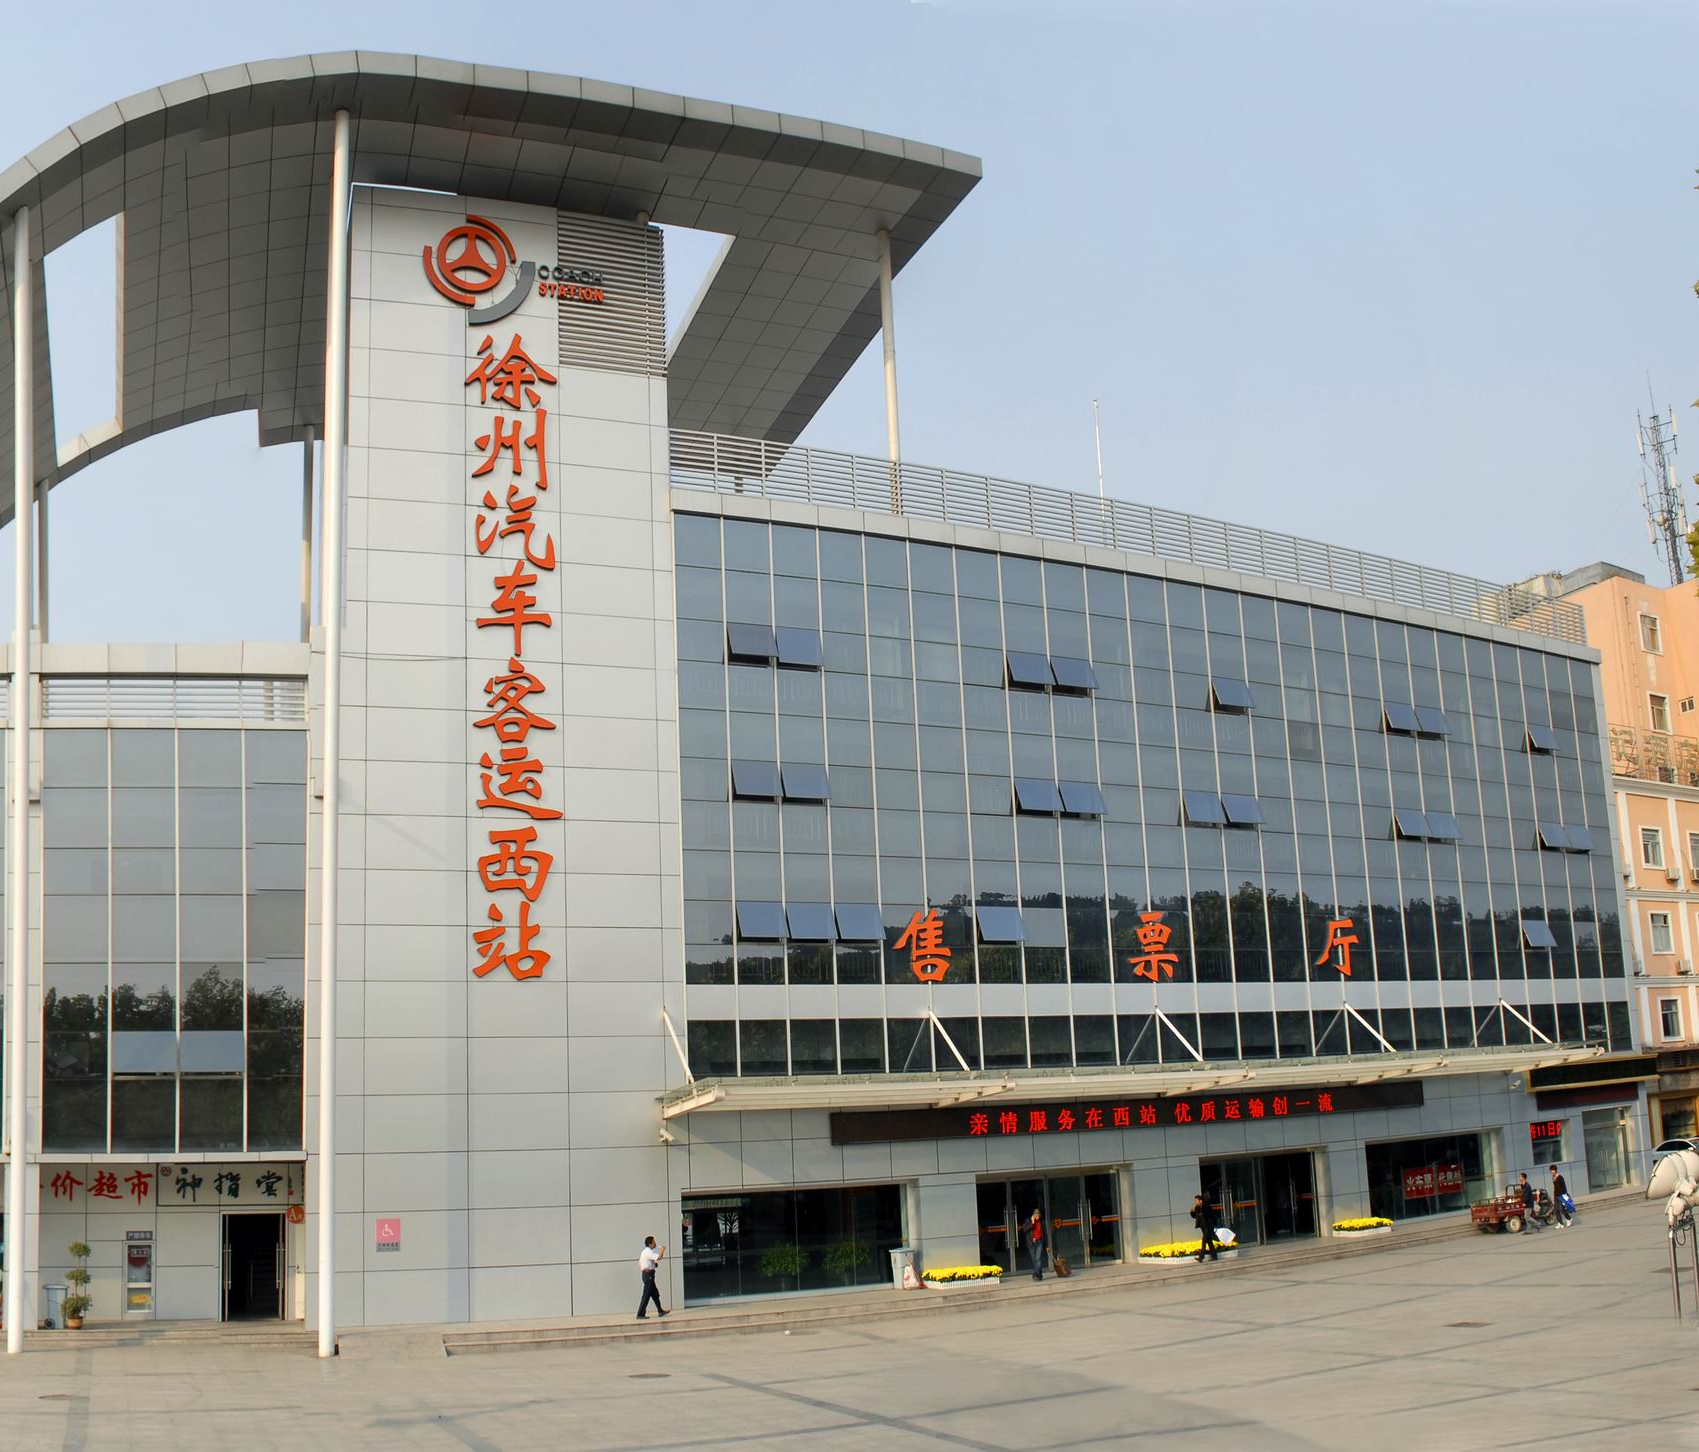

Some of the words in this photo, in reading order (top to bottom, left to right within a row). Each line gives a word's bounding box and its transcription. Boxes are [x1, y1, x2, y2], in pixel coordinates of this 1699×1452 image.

[538, 265, 603, 284] COACH
[539, 282, 604, 303] STATION
[464, 333, 564, 982] 徐州汽车客运西站
[893, 907, 1360, 983] 售票厅
[969, 1103, 1157, 1136] 亲情服务在西站
[1174, 1093, 1334, 1124] 优质运输创一流
[40, 1170, 153, 1205] 价超市
